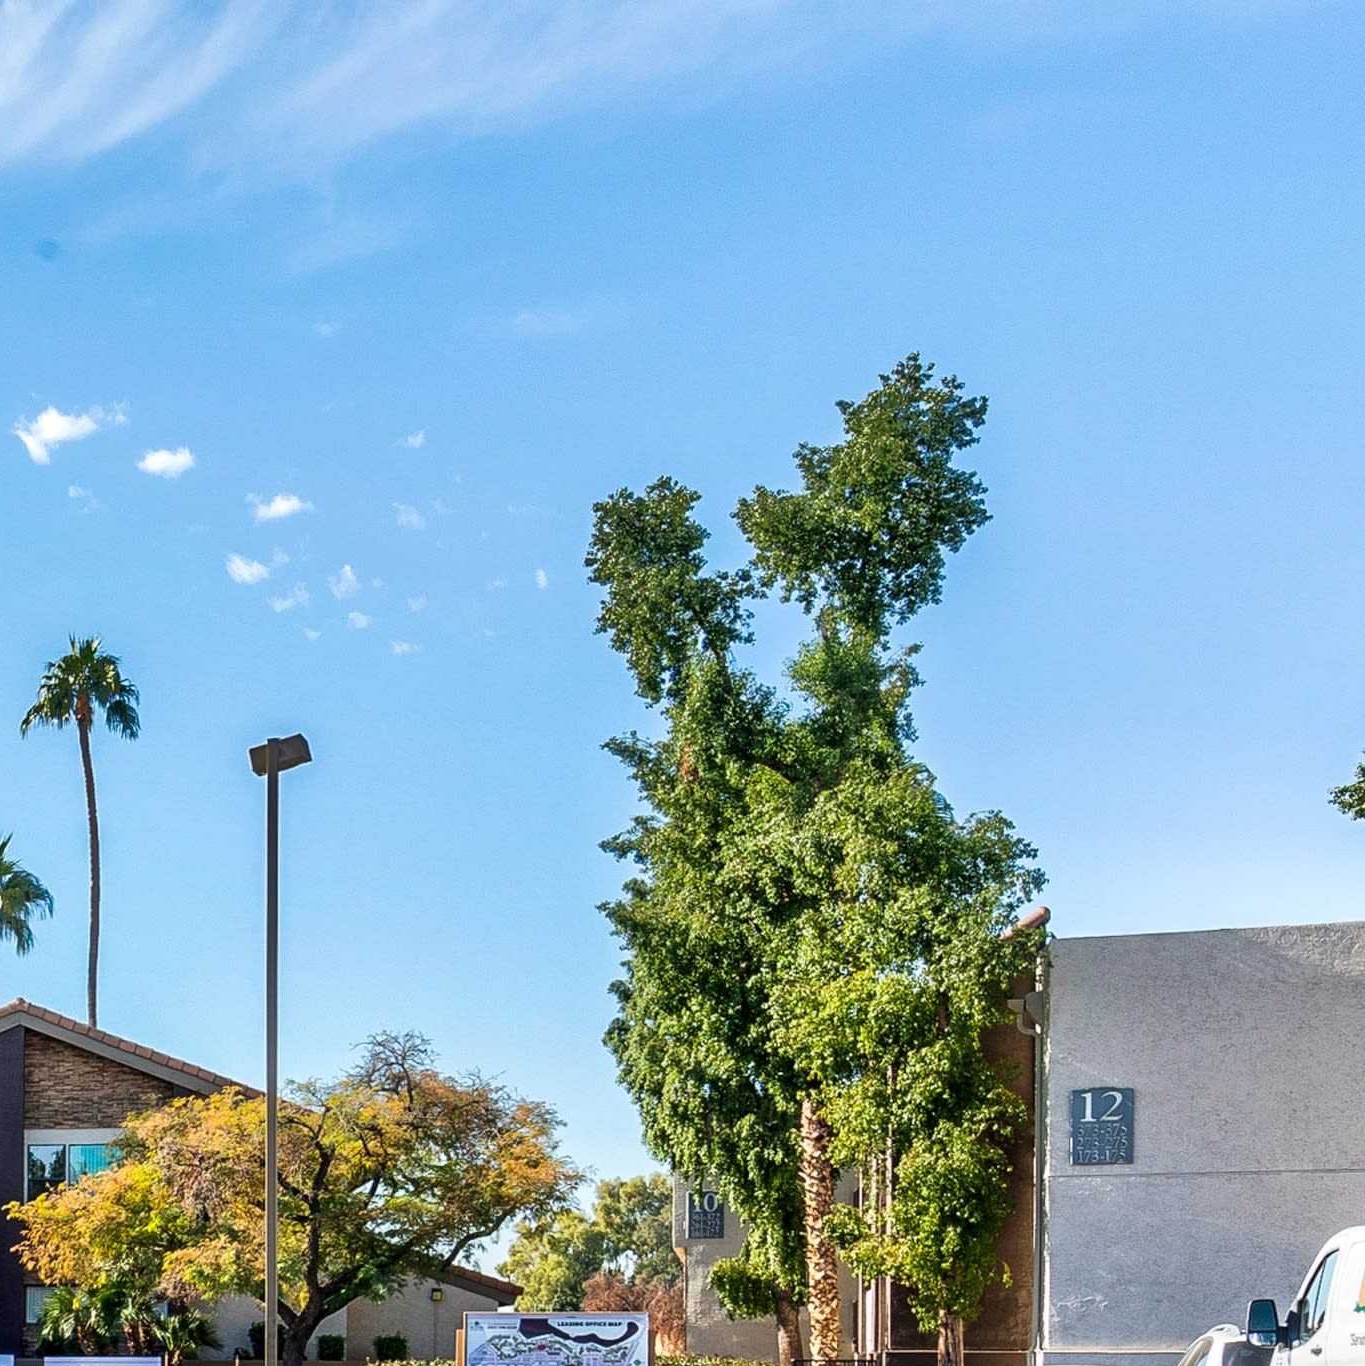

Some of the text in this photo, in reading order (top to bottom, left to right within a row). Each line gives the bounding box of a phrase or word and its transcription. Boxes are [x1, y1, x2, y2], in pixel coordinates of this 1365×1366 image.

[1079, 1090, 1124, 1122] 12
[1077, 1124, 1128, 1137] 373-375
[1076, 1136, 1129, 1150] 273-275
[1077, 1149, 1127, 1163] 173-175
